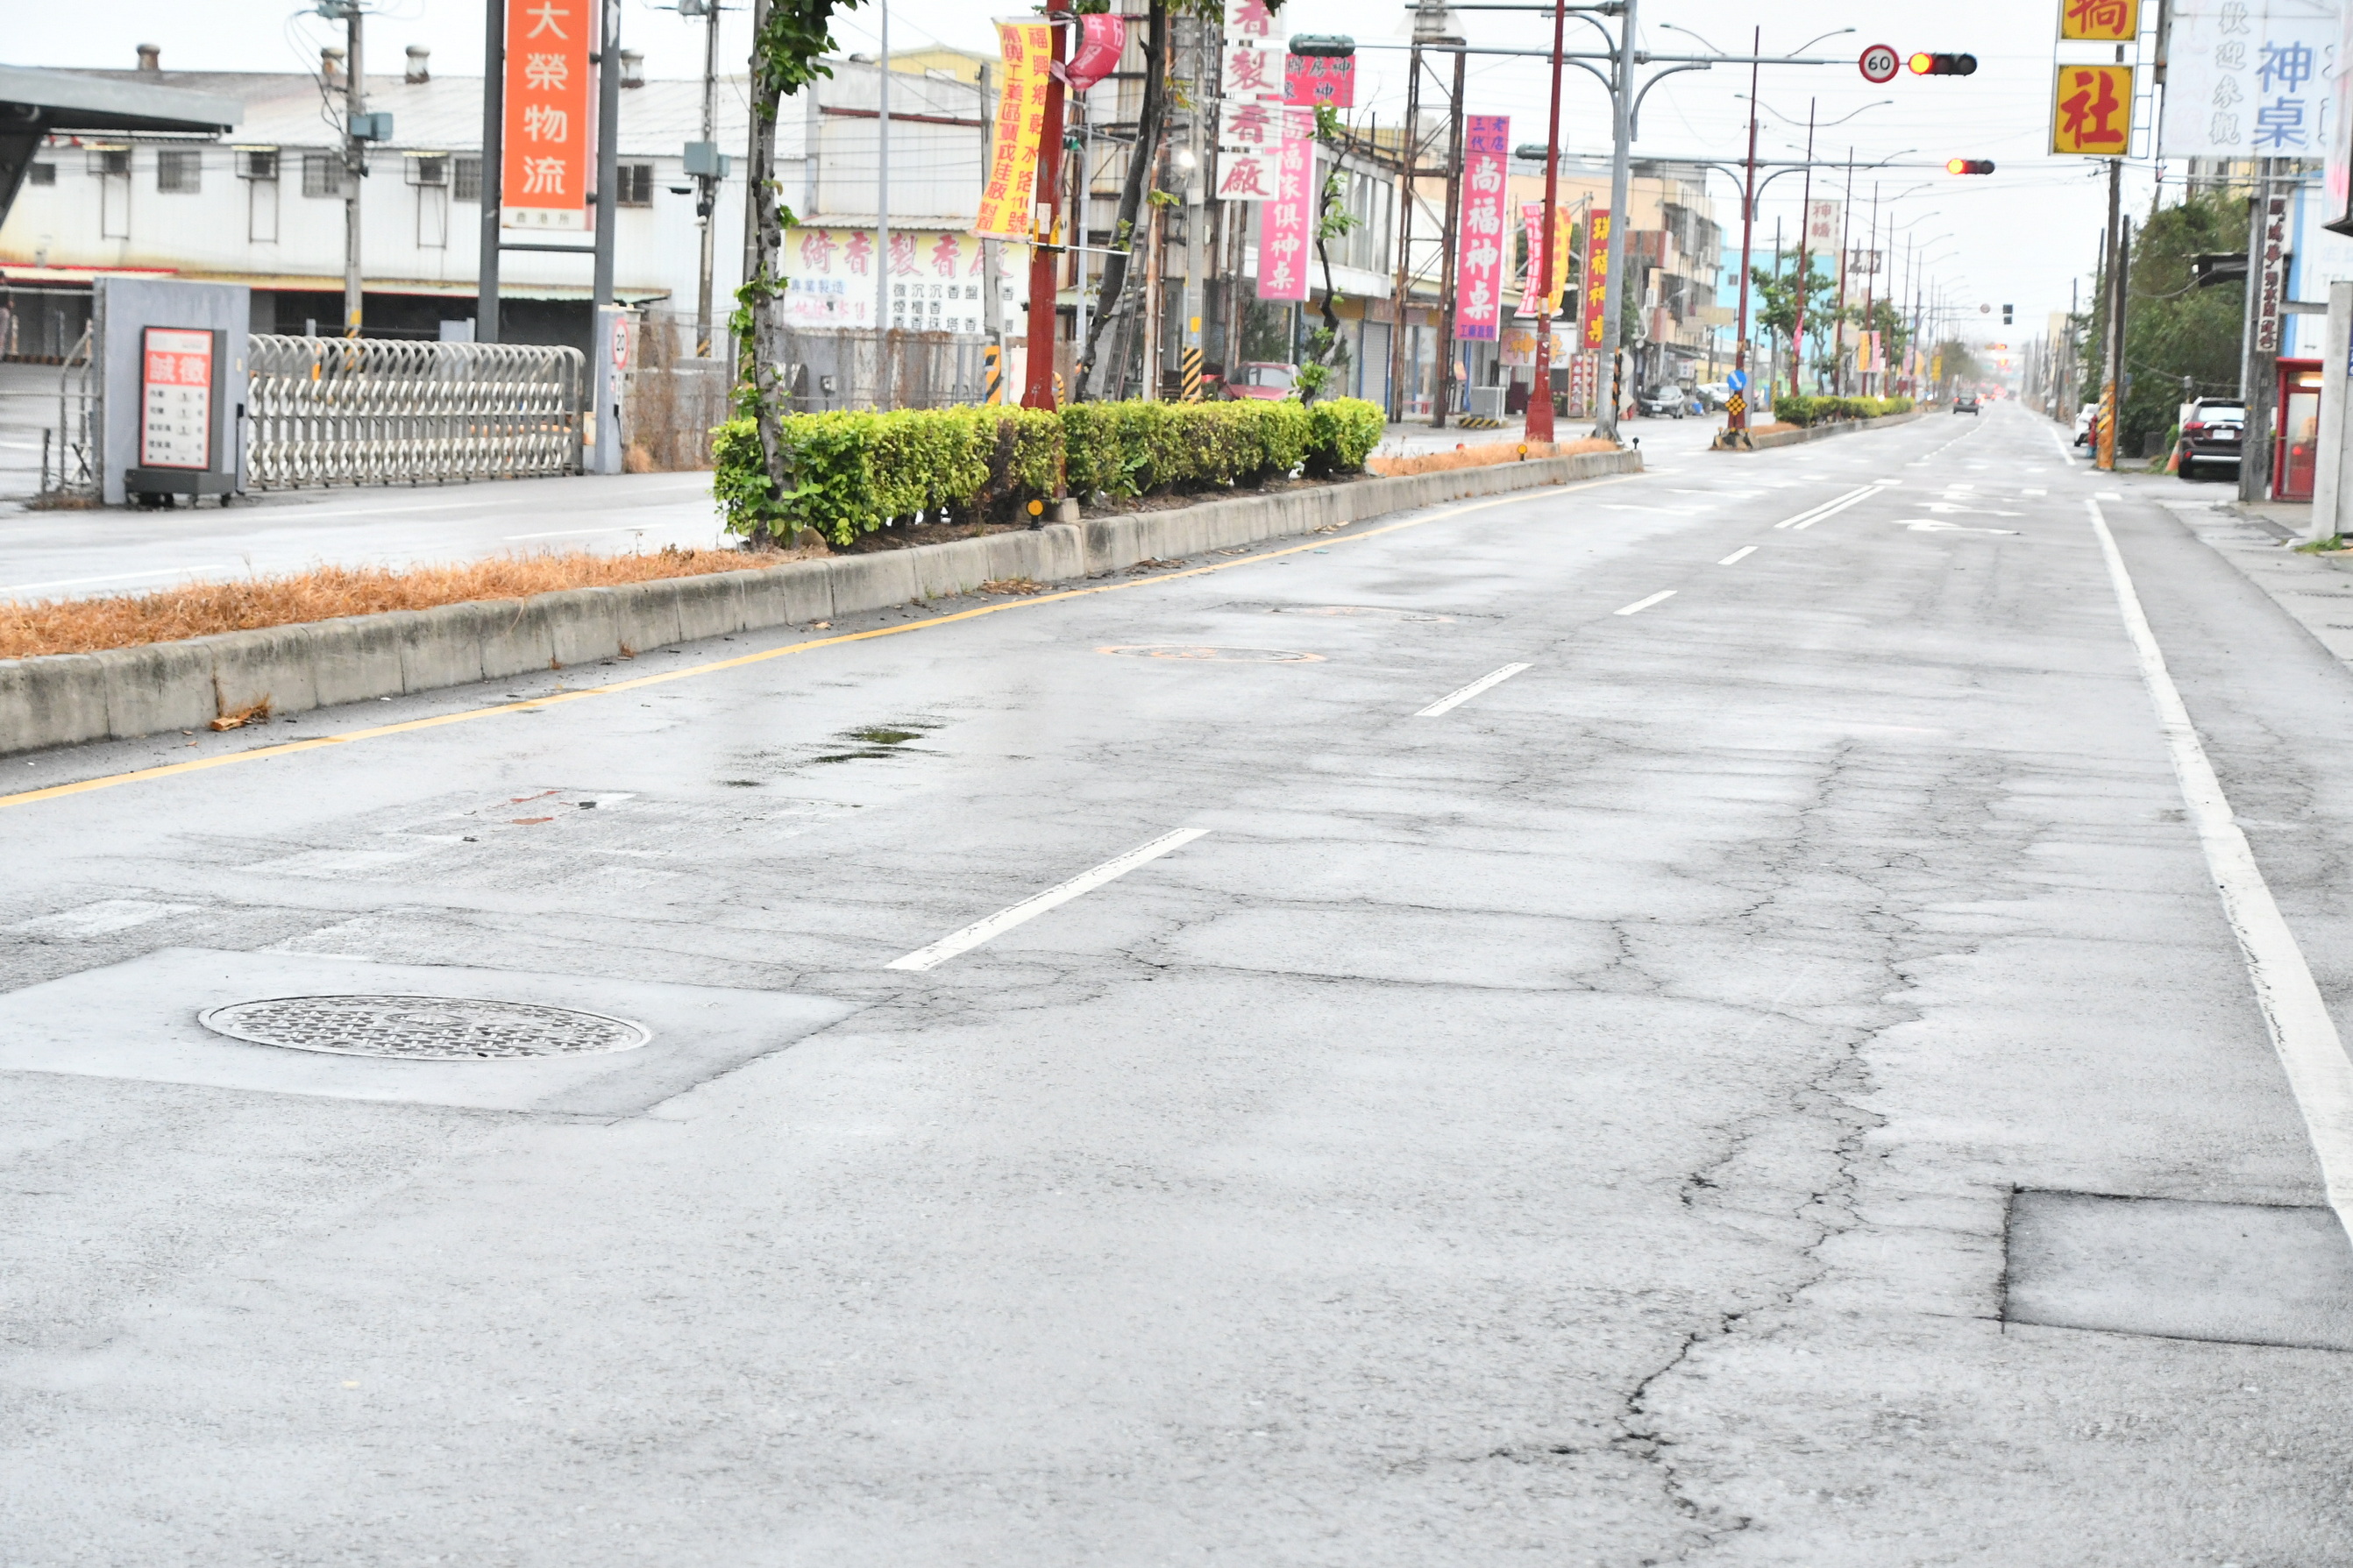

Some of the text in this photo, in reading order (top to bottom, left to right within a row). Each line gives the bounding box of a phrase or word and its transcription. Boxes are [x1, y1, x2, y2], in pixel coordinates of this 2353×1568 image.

[522, 1, 570, 195] 大榮物流
[1219, 0, 1274, 196] 香製香廠
[1868, 56, 1890, 70] 60
[2250, 39, 2313, 148] 神桌
[1470, 117, 1486, 152] 三代
[1490, 117, 1507, 151] 老店
[1464, 156, 1502, 321] 尚福神桌
